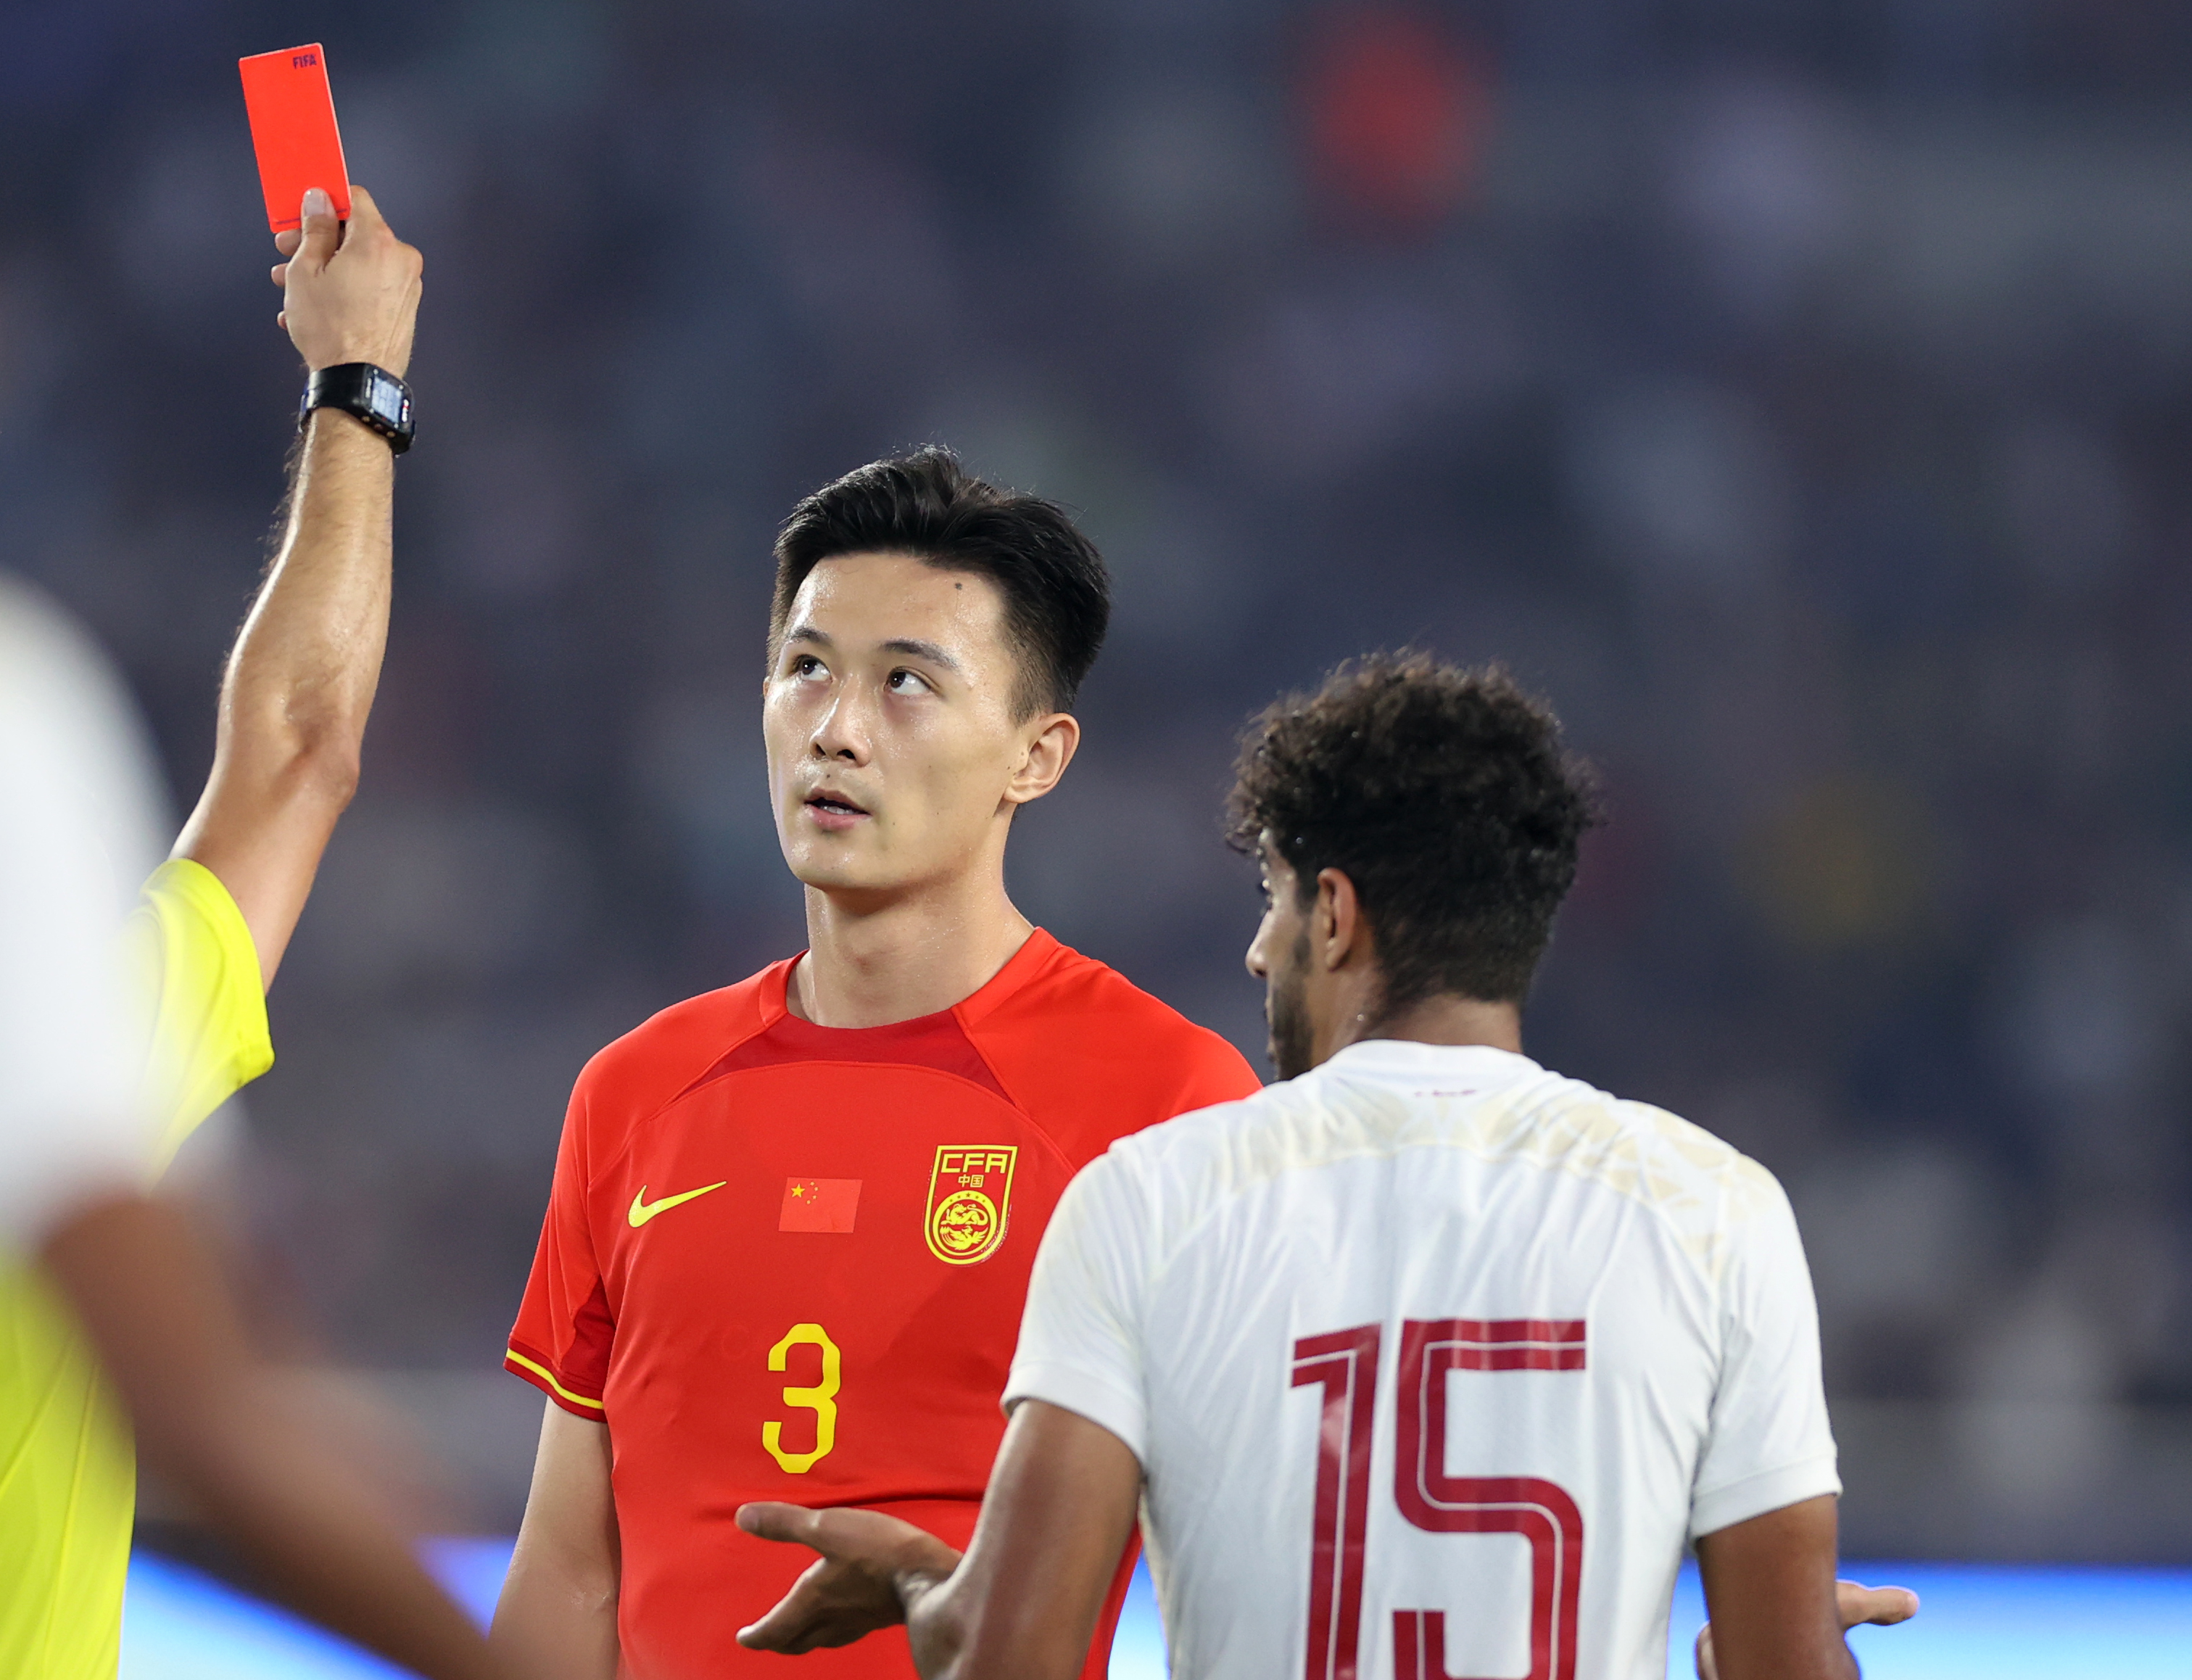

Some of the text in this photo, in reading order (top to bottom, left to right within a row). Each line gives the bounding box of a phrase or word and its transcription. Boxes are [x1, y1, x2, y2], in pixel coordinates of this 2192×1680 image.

[293, 54, 317, 69] FIFA
[940, 1153, 1008, 1173] CFA
[958, 1174, 984, 1188] 中国
[762, 1323, 840, 1473] 3
[1290, 1319, 1587, 1680] 15
